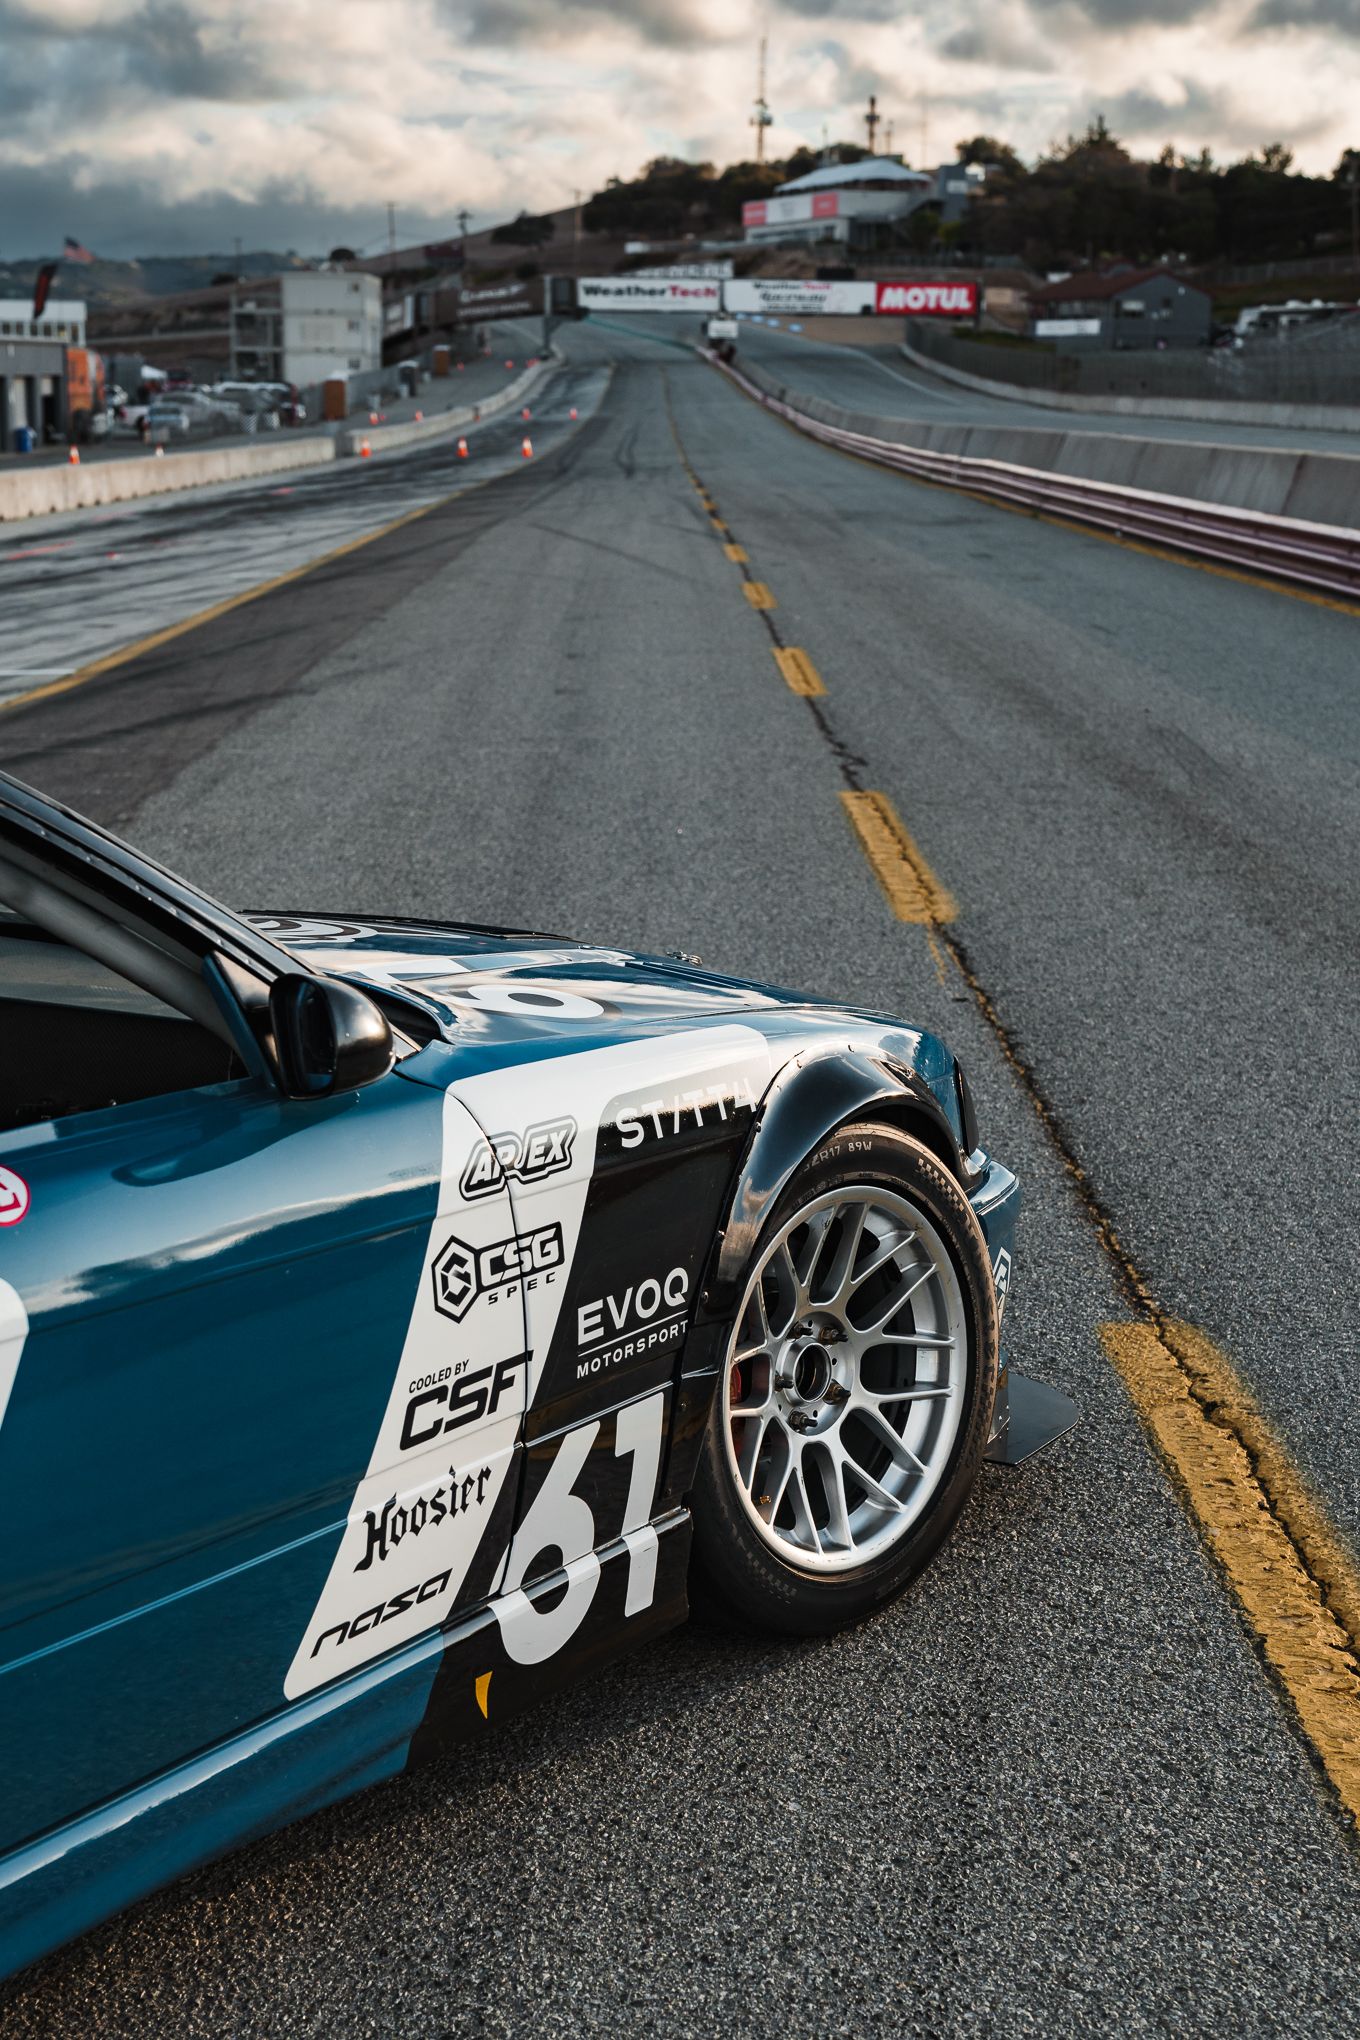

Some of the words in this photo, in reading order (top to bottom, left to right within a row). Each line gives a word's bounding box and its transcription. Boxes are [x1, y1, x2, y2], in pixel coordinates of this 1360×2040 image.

[583, 284, 718, 298] WeatherTech
[879, 286, 972, 310] MOTUL
[469, 1128, 568, 1186] APEX
[848, 1141, 872, 1152] 89W
[480, 1228, 560, 1287] CSG
[488, 1272, 556, 1305] SPEC
[577, 1267, 689, 1346] EVOQ
[408, 1366, 452, 1394] COOLED
[454, 1359, 470, 1376] BY
[576, 1319, 689, 1379] MOTORSPORT
[399, 1349, 535, 1451] CSF
[353, 1464, 492, 1574] Hoosier
[487, 1391, 665, 1665] 61
